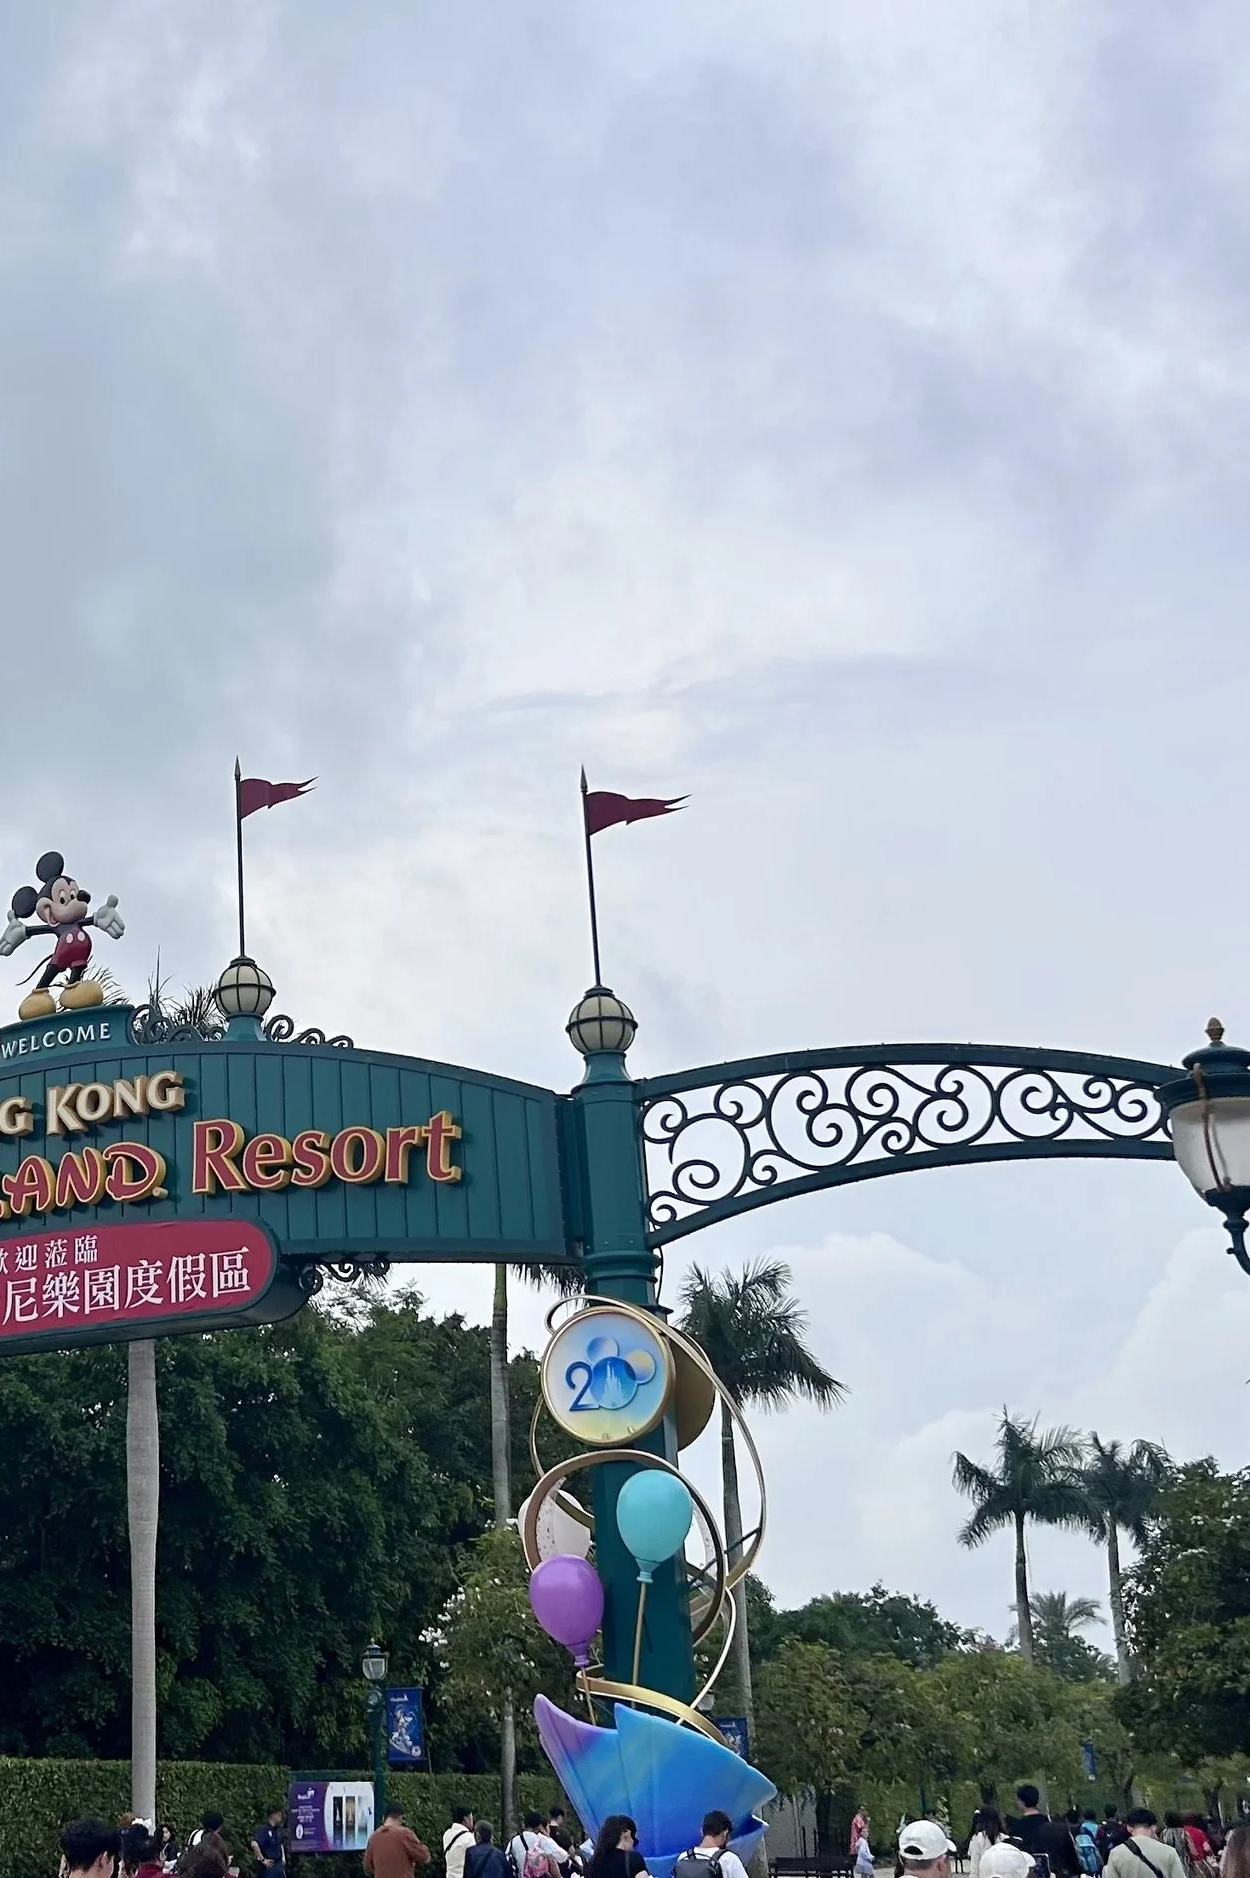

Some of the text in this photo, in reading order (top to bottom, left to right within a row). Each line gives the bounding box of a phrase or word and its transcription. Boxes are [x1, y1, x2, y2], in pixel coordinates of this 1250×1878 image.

[1, 1023, 111, 1059] WELCOME
[46, 1070, 186, 1137] KONG
[192, 1110, 462, 1194] Resort
